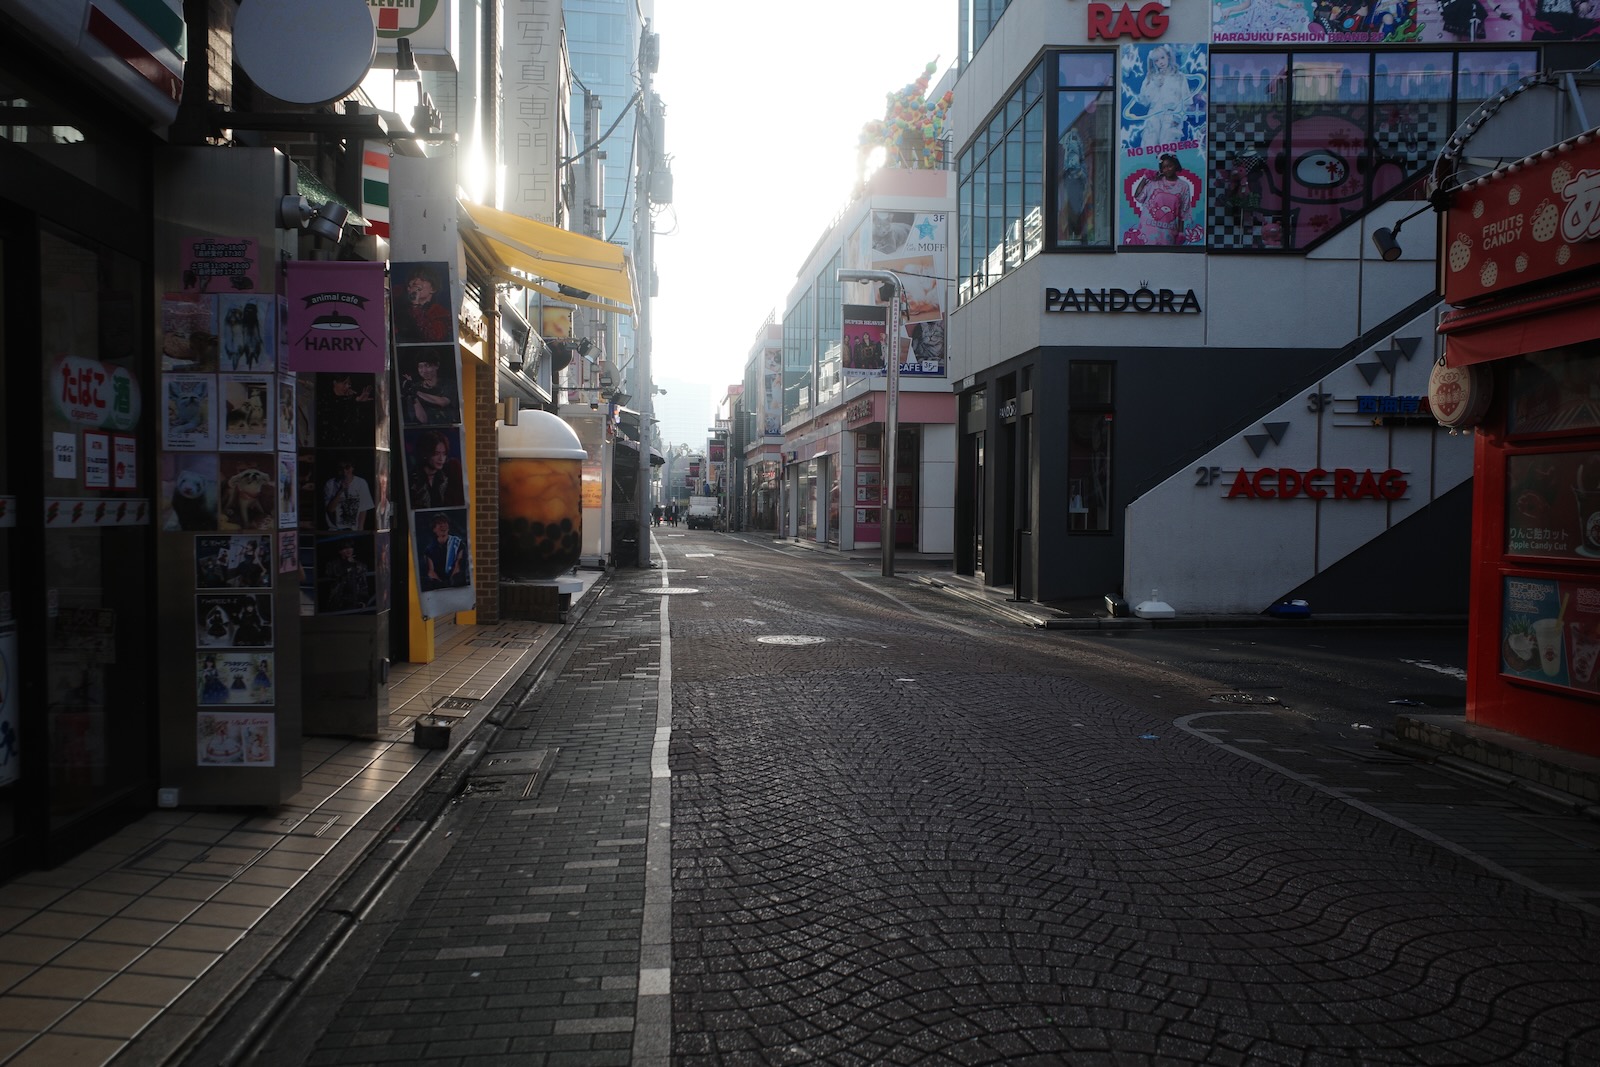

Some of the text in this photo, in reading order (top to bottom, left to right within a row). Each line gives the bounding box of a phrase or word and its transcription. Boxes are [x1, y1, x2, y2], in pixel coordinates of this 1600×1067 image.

[1088, 2, 1169, 39] RAG
[1213, 32, 1385, 42] HARAJUKU FASHION BRAND 2F
[1128, 140, 1199, 157] NO BORDERS
[933, 214, 945, 222] 3F
[1482, 213, 1523, 238] FRUITS
[1483, 227, 1523, 250] CANDY
[311, 294, 359, 304] animal cafe
[1046, 287, 1202, 313] PANDORA
[305, 337, 366, 351] HARRY
[62, 363, 106, 409] たばこ
[1307, 393, 1332, 413] 3F
[1195, 466, 1220, 486] 2F
[1228, 467, 1407, 500] ACDC RAG
[1510, 527, 1568, 540] りんご飴カット
[1509, 541, 1567, 552] Apple Candy Cut
